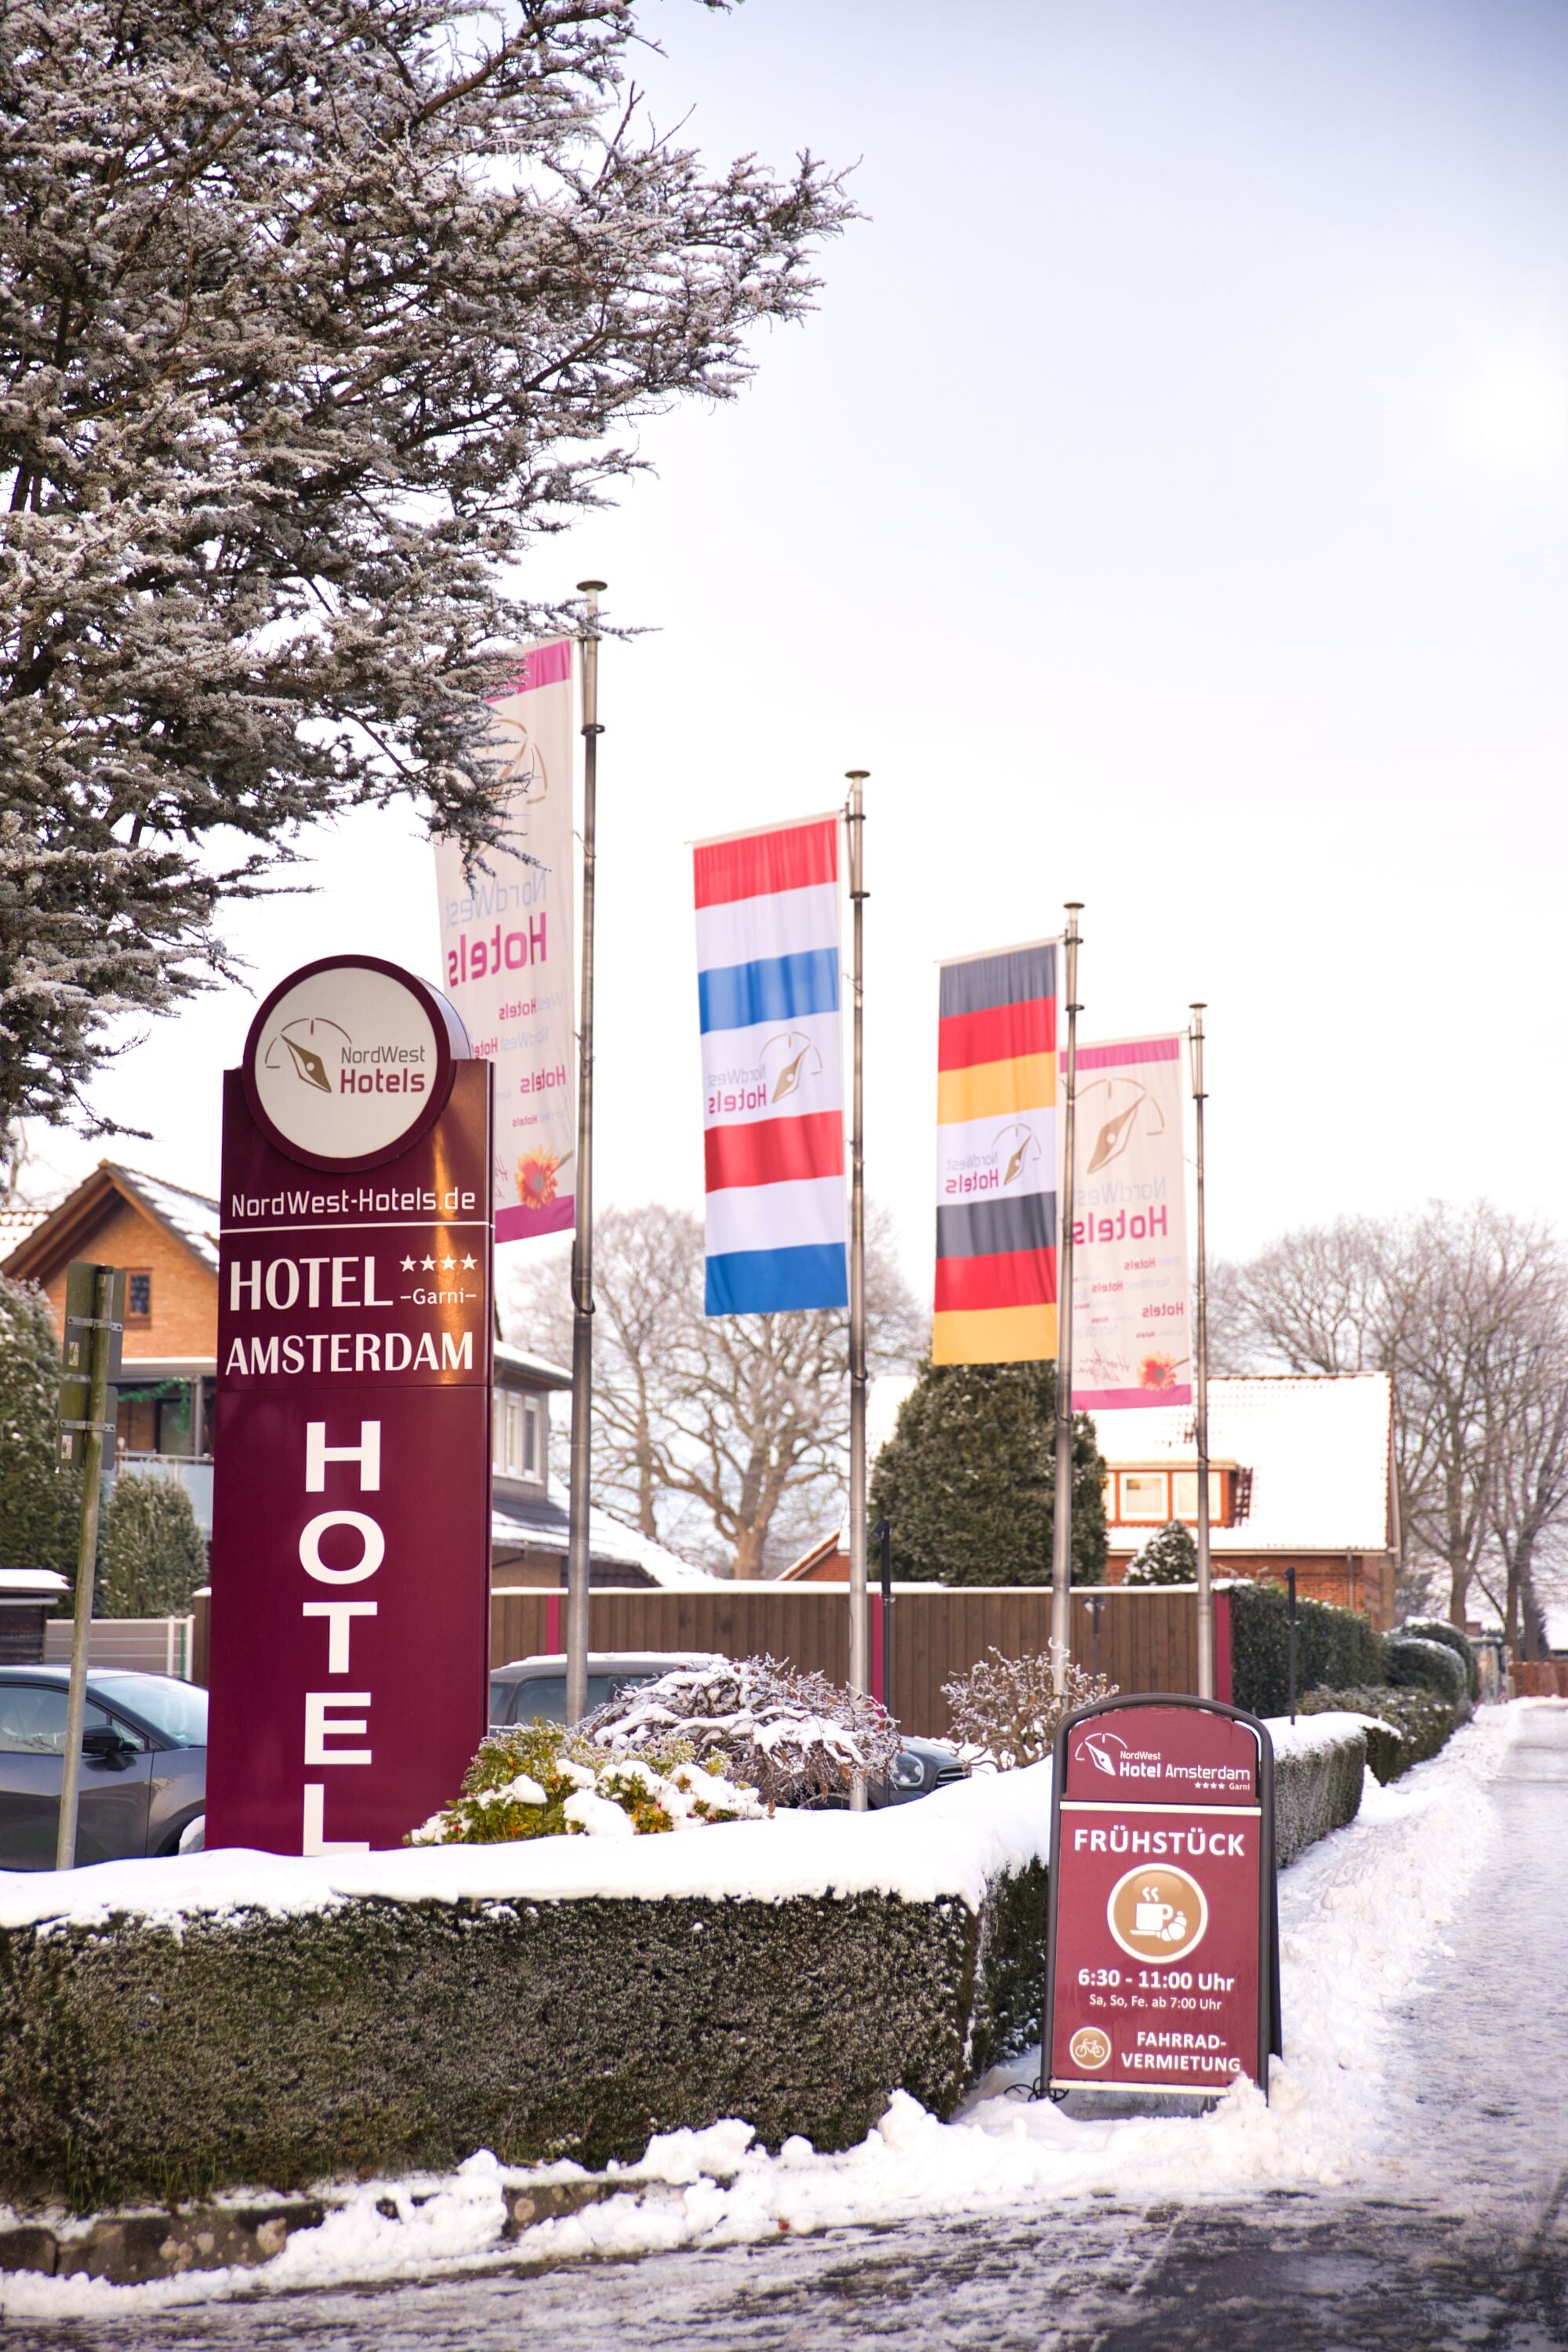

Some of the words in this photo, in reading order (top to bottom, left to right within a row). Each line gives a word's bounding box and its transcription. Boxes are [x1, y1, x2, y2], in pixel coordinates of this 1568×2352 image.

[341, 1046, 425, 1065] NordWest
[339, 1068, 425, 1094] Hotels
[232, 1186, 476, 1218] NordWest-Hotels.de
[230, 1256, 394, 1312] HOTEL
[225, 1331, 473, 1376] AMSTERDAM
[299, 1421, 385, 1857] HOTEL
[1120, 1751, 1161, 1760] NordWest
[1120, 1762, 1161, 1778] Hotel
[1165, 1764, 1250, 1780] Amsterdam
[1229, 1782, 1250, 1791] Garni
[1074, 1824, 1245, 1857] FRÜHSTÜCK
[1078, 1969, 1120, 1987] 6:30
[1138, 1970, 1192, 1990] 11:00
[1198, 1973, 1235, 1991] Uhr
[1089, 1994, 1107, 2007] Sa,
[1110, 1994, 1127, 2008] So,
[1131, 1995, 1148, 2008] Fe.
[1152, 1996, 1167, 2008] ab
[1170, 1997, 1196, 2009] 7:00
[1200, 1998, 1222, 2011] Uhr
[1137, 2031, 1227, 2049] FAHRRAD-
[1121, 2053, 1241, 2072] VERMIETUNG
